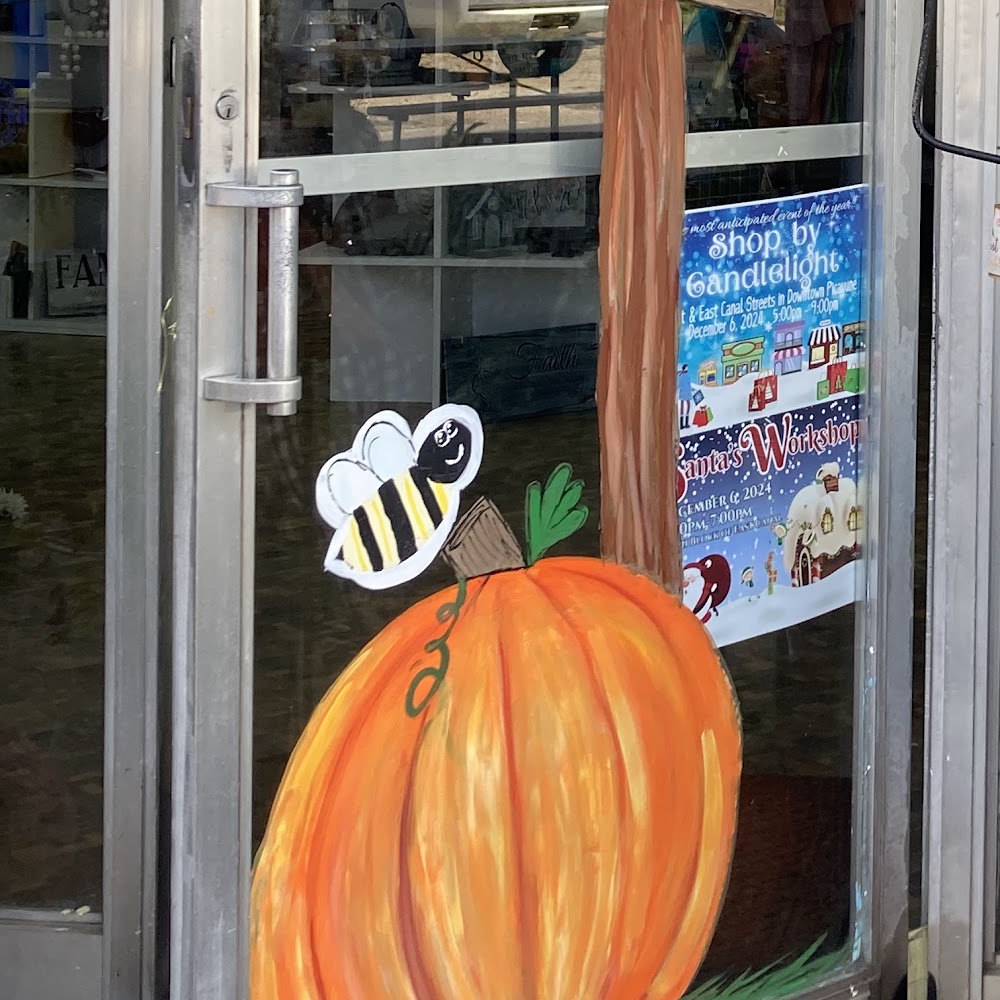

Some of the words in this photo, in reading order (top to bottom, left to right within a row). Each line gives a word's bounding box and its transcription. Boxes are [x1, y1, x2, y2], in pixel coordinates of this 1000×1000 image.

[777, 205, 803, 221] event
[814, 202, 830, 217] the
[709, 229, 782, 260] Shop
[792, 221, 822, 251] by
[686, 249, 840, 299] Candlelight
[688, 321, 727, 340] December
[772, 306, 804, 324] 5:00pm
[810, 298, 839, 315] 9:00pm
[689, 305, 696, 324] &
[699, 304, 718, 321] East
[721, 299, 744, 316] Canal
[745, 294, 775, 311] Streets
[778, 292, 786, 303] in
[786, 286, 825, 305] Downtown
[678, 494, 727, 518] CEMBER
[742, 481, 772, 501] 2024
